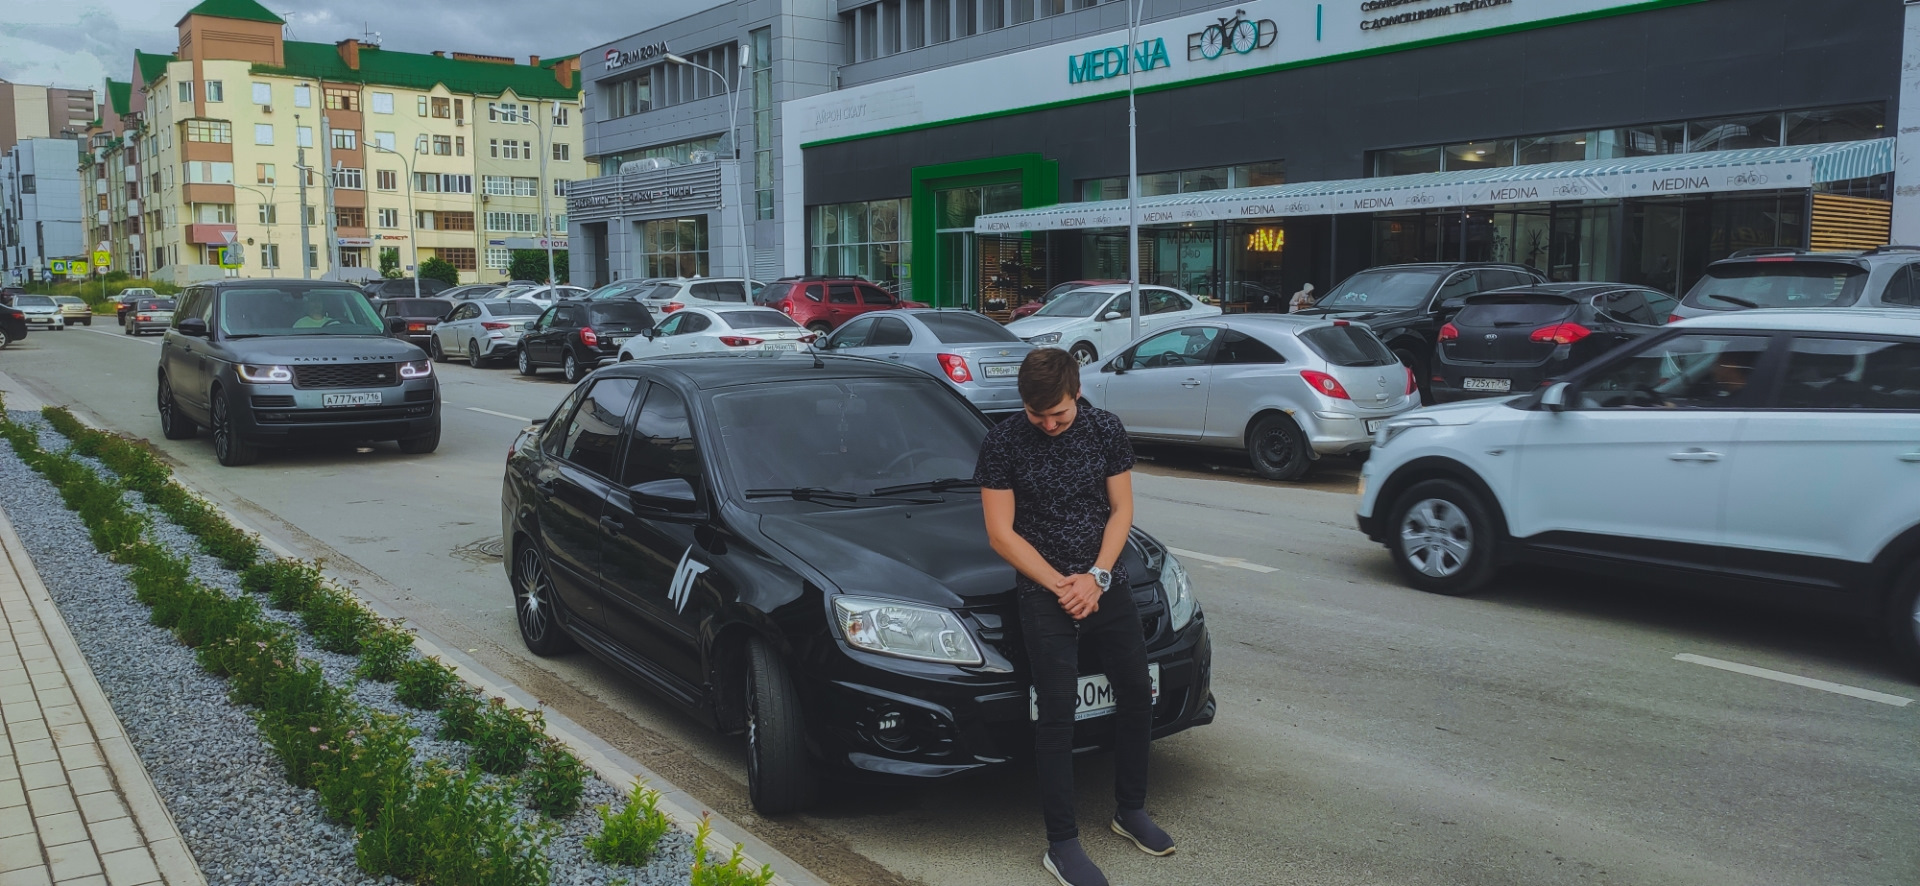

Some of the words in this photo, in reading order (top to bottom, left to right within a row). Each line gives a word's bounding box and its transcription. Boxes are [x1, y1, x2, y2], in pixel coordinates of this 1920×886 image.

[621, 41, 670, 67] RIMZONA
[1069, 37, 1170, 84] MEDINA
[815, 107, 842, 126] АЙРОН
[844, 103, 867, 119] СКАУТ
[1652, 176, 1710, 191] MEDINA
[1490, 186, 1539, 201] MEDINA
[1240, 204, 1275, 216] MEDINA
[1354, 197, 1394, 209] MEDINA
[1060, 217, 1087, 227] MEDINA
[1143, 212, 1173, 222] MEDINA
[987, 222, 1011, 231] MEDINA
[1167, 231, 1212, 246] MDINA
